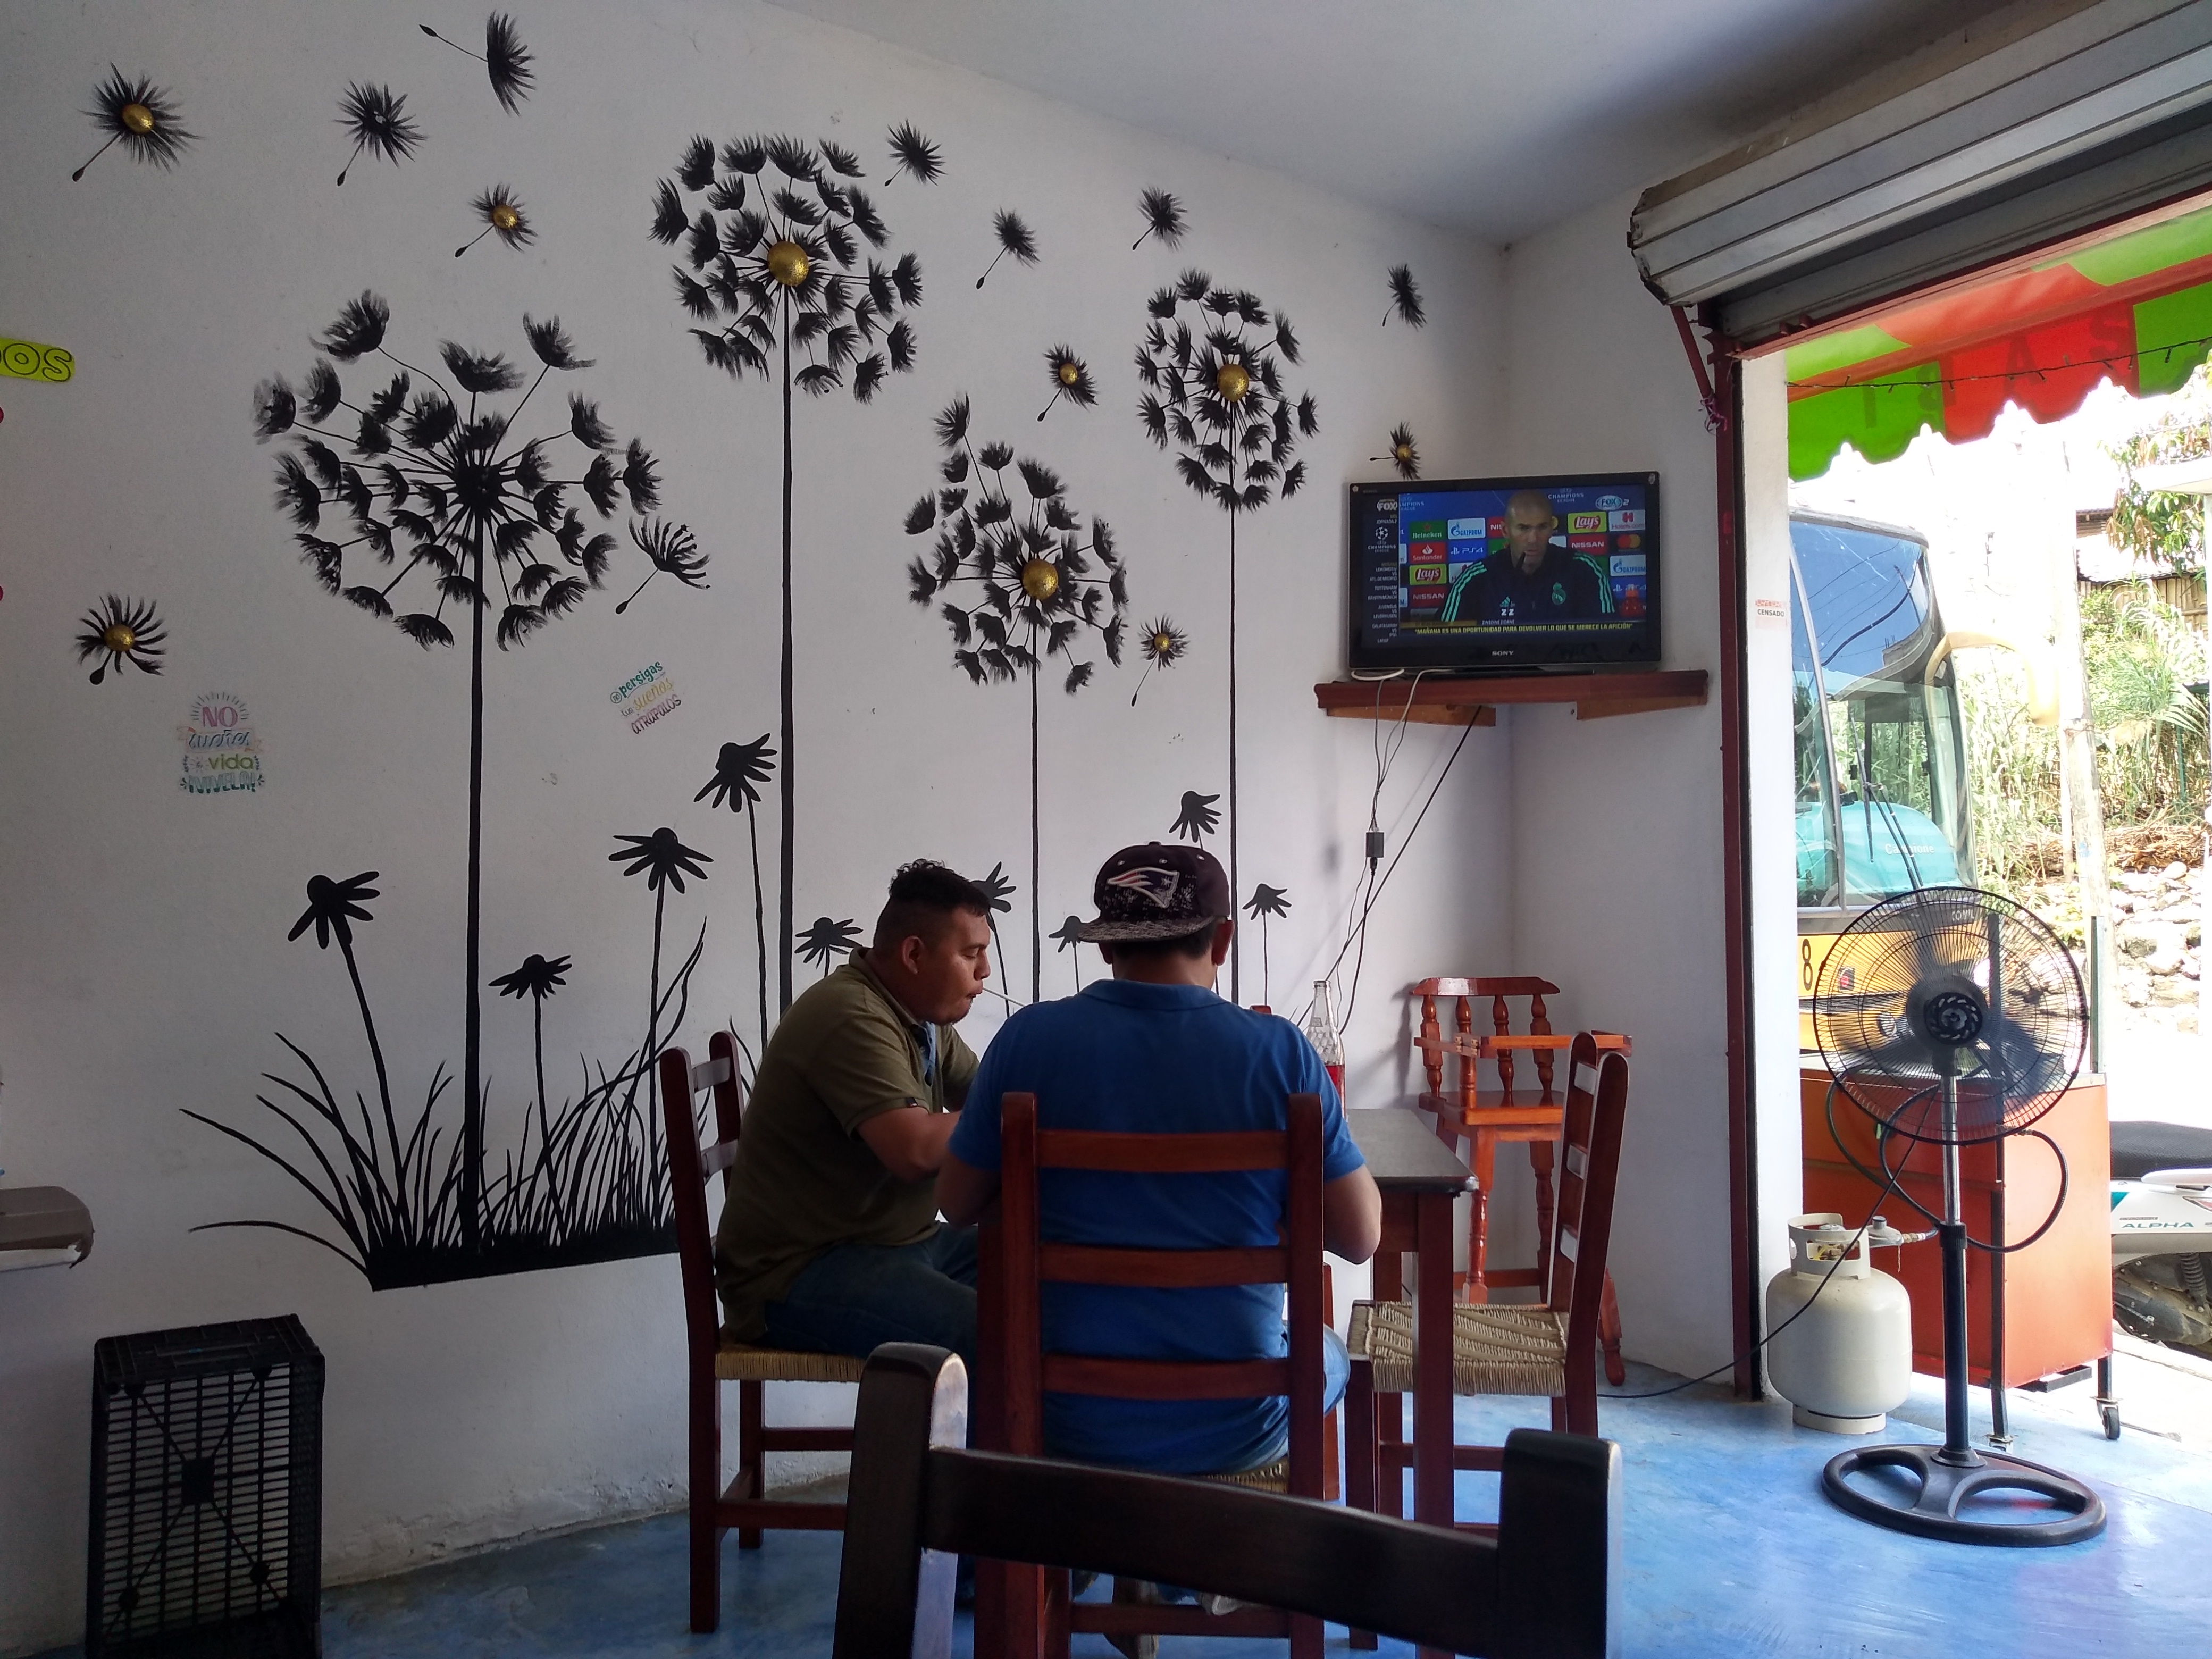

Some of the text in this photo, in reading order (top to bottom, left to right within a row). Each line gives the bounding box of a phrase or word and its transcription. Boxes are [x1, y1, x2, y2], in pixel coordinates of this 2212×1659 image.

[1376, 502, 1397, 511] FOX
[618, 661, 663, 698] persigas
[621, 677, 673, 717] tus sueños
[203, 706, 238, 727] NO
[208, 753, 253, 770] vida
